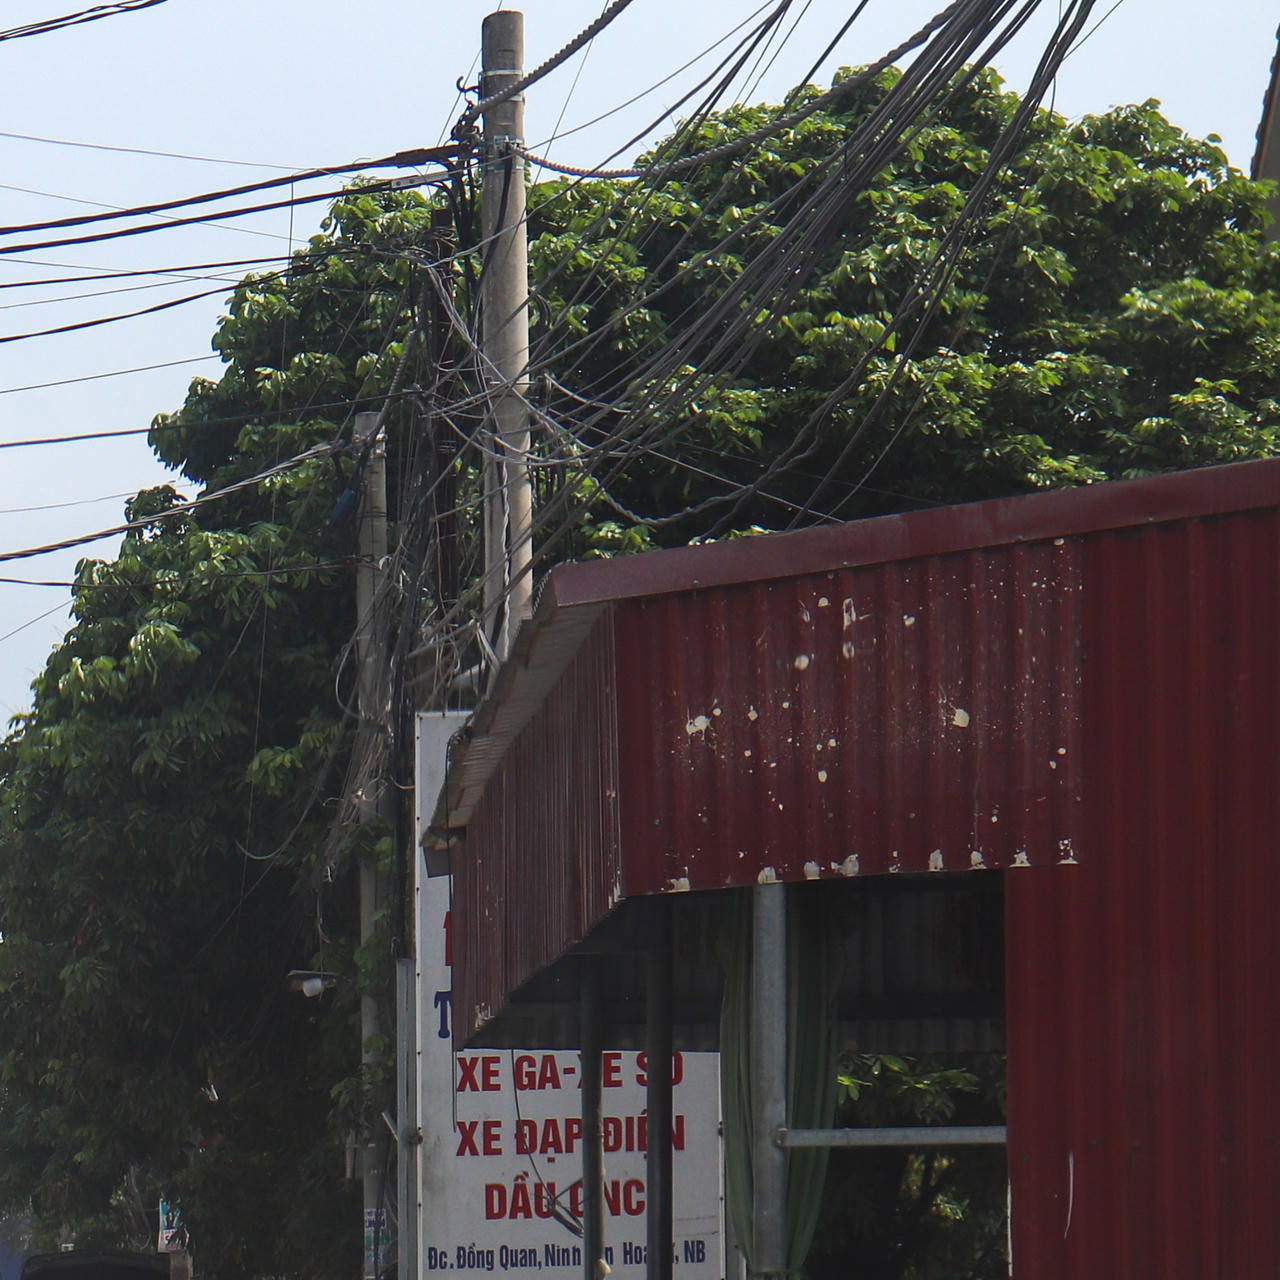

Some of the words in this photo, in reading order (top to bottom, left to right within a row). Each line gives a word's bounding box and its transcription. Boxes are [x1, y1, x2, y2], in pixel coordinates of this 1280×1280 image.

[456, 1056, 501, 1091] XE
[456, 1120, 502, 1156] XE
[514, 1118, 583, 1163] ĐẠP
[499, 1244, 542, 1271] Quan,
[545, 1243, 582, 1267] Ninh
[684, 1239, 705, 1264] NB
